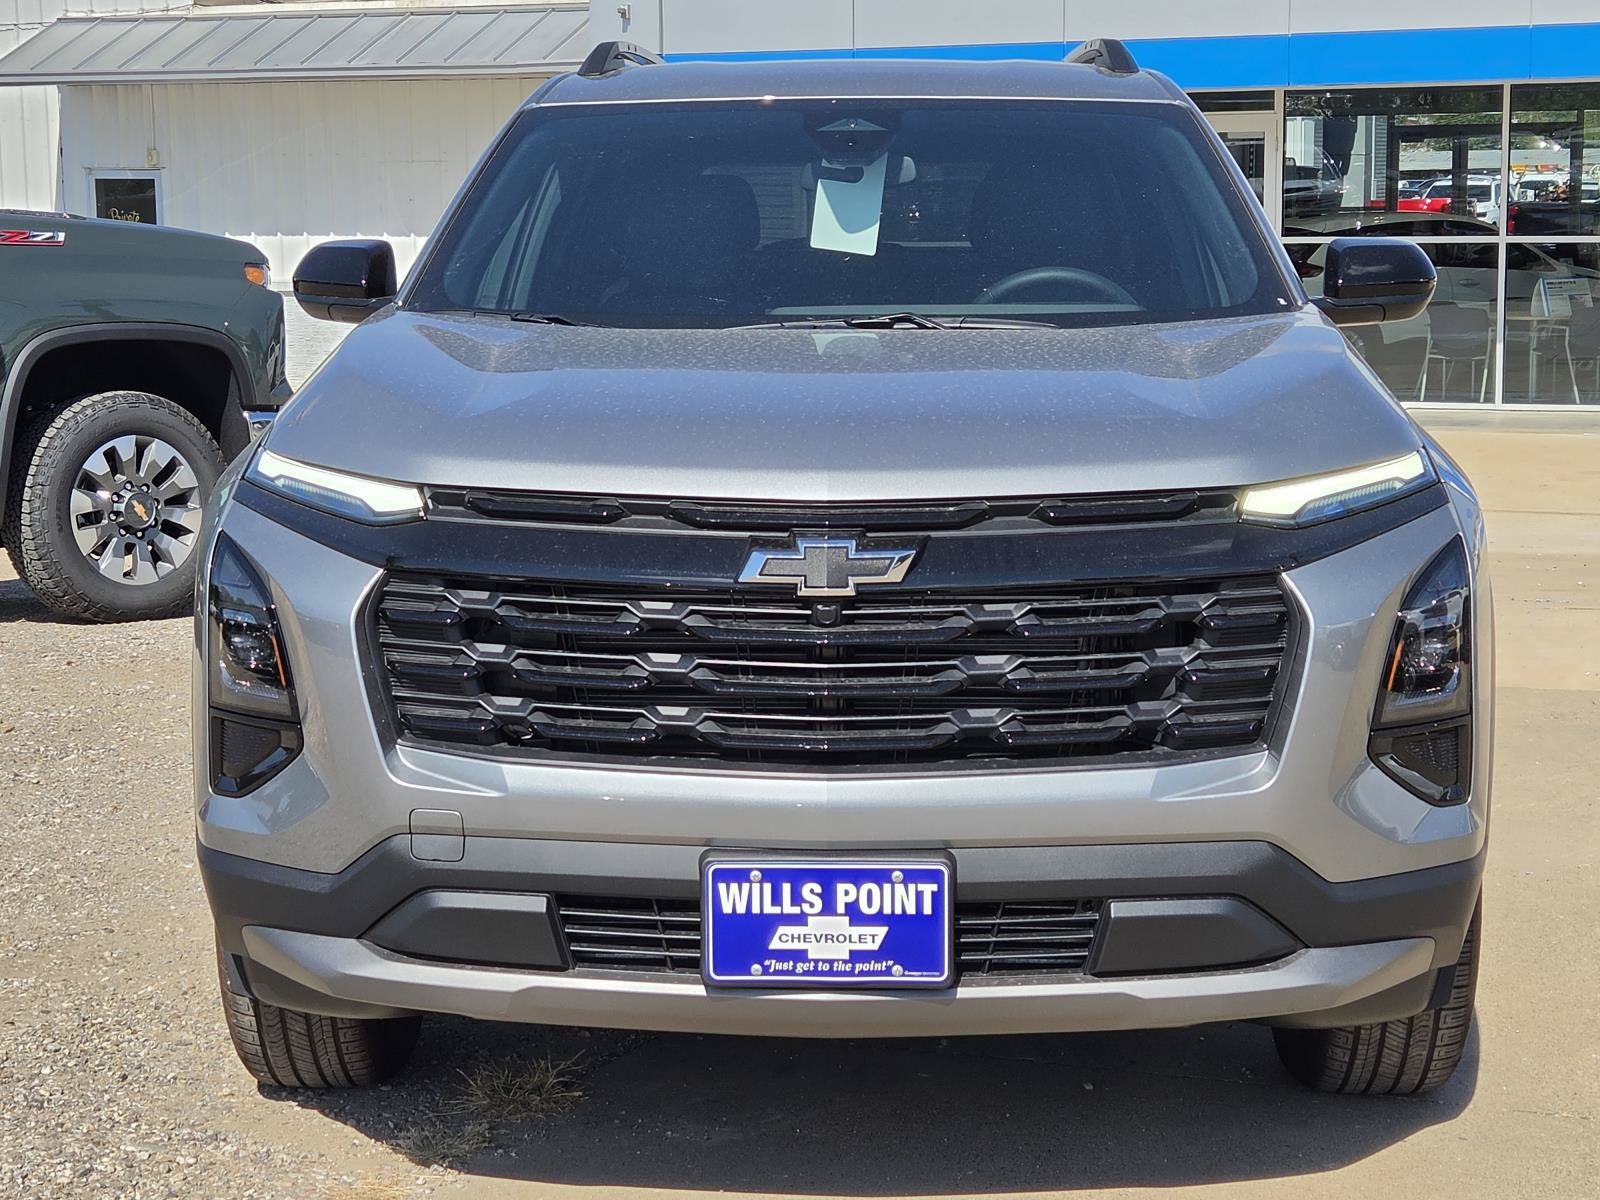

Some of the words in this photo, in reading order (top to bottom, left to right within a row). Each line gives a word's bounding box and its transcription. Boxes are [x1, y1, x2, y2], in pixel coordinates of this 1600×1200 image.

[0, 230, 66, 243] Z71
[717, 882, 823, 915] WILLS
[836, 882, 938, 915] POINT
[778, 933, 879, 944] CHEVROLET
[764, 959, 794, 973] “Just
[795, 960, 815, 974] get
[817, 960, 830, 972] to
[833, 960, 852, 972] the
[854, 959, 895, 974] point”
